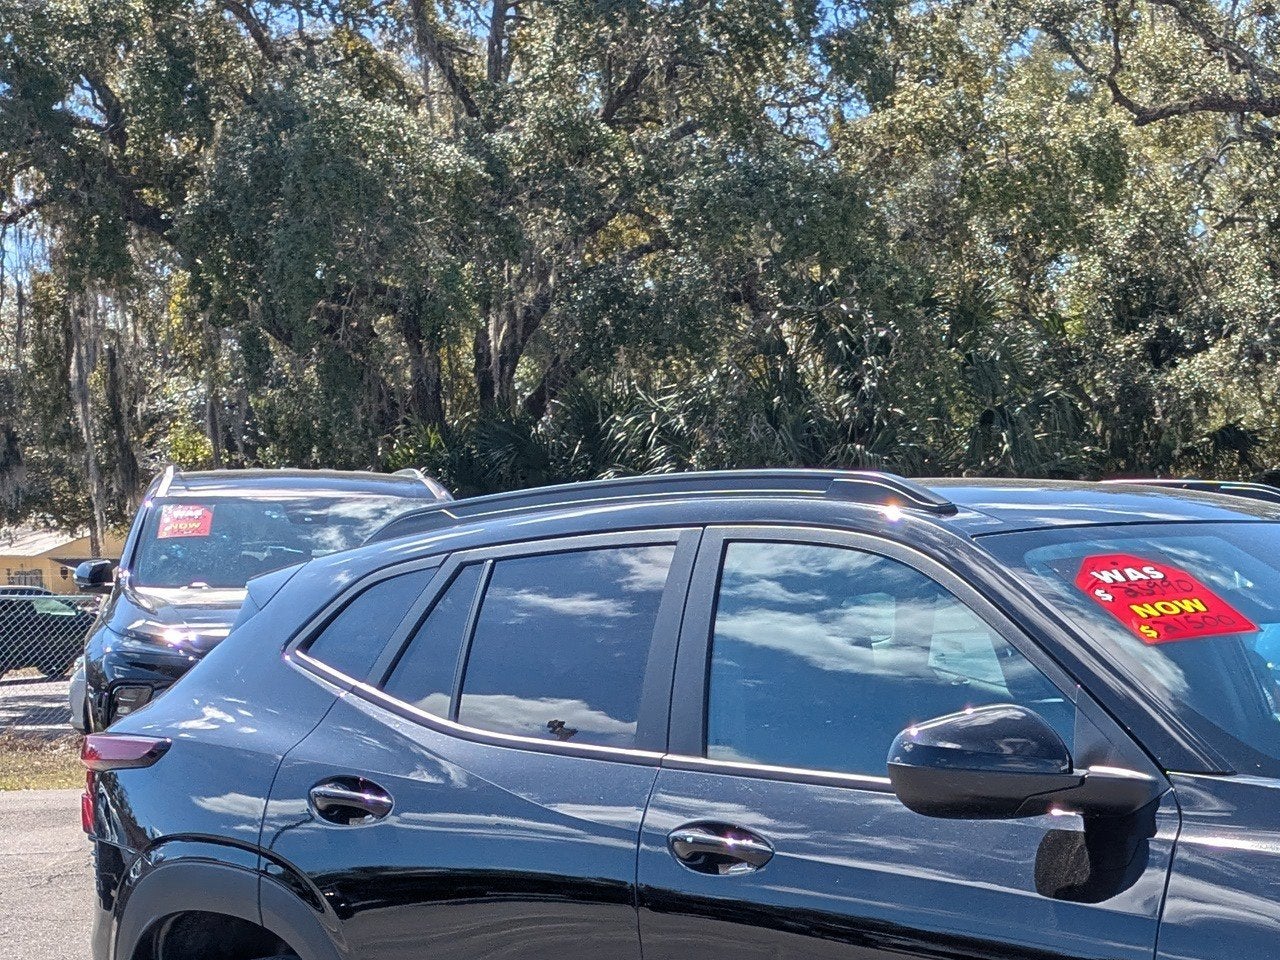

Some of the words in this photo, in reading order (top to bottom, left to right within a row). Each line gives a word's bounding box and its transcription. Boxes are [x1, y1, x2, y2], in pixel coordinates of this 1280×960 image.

[1090, 566, 1165, 584] WAS
[1094, 588, 1114, 602] $
[1129, 598, 1207, 618] NOW
[1139, 624, 1158, 639] $
